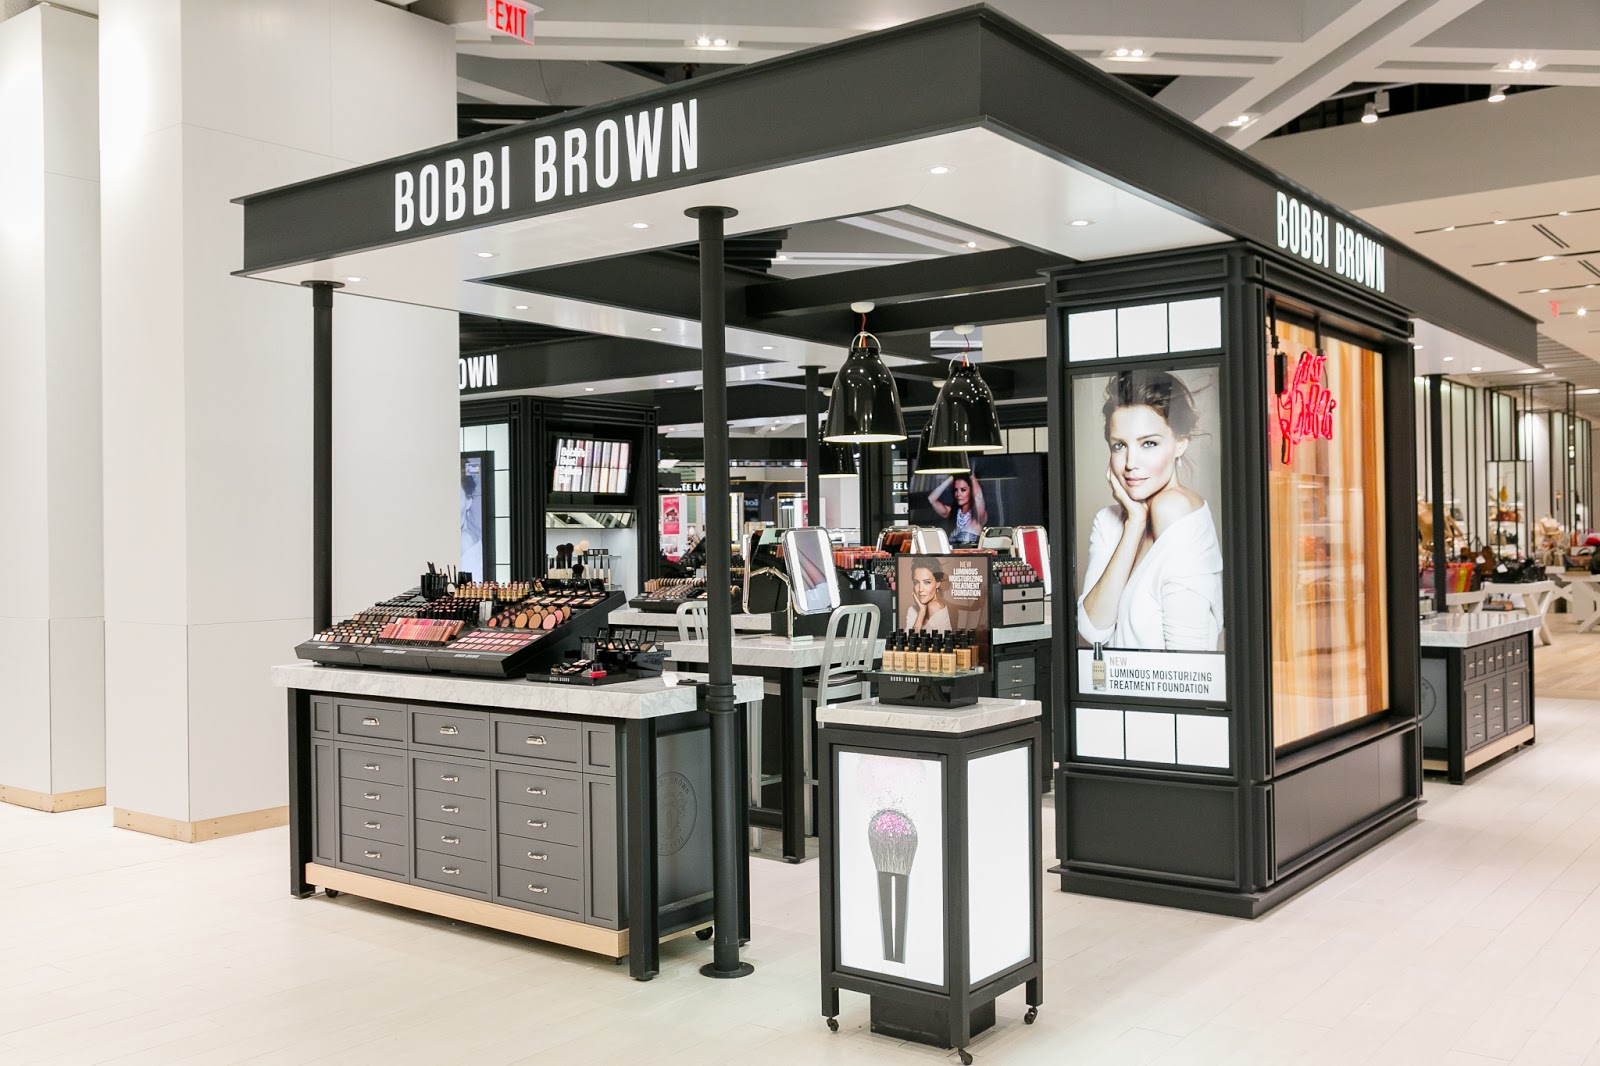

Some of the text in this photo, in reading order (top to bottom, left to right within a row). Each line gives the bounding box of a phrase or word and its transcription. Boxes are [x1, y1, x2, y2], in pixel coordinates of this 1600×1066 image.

[495, 0, 527, 38] EXIT
[394, 98, 699, 233] BOBBI BROWN
[1276, 191, 1385, 294] BOBBI BROWN
[459, 353, 498, 391] OWN
[1109, 657, 1127, 667] NEW
[1109, 668, 1151, 679] LUMINOUS
[1152, 670, 1212, 682] MOISTURIZING
[1109, 680, 1209, 694] TREATMENT FOUNDATION
